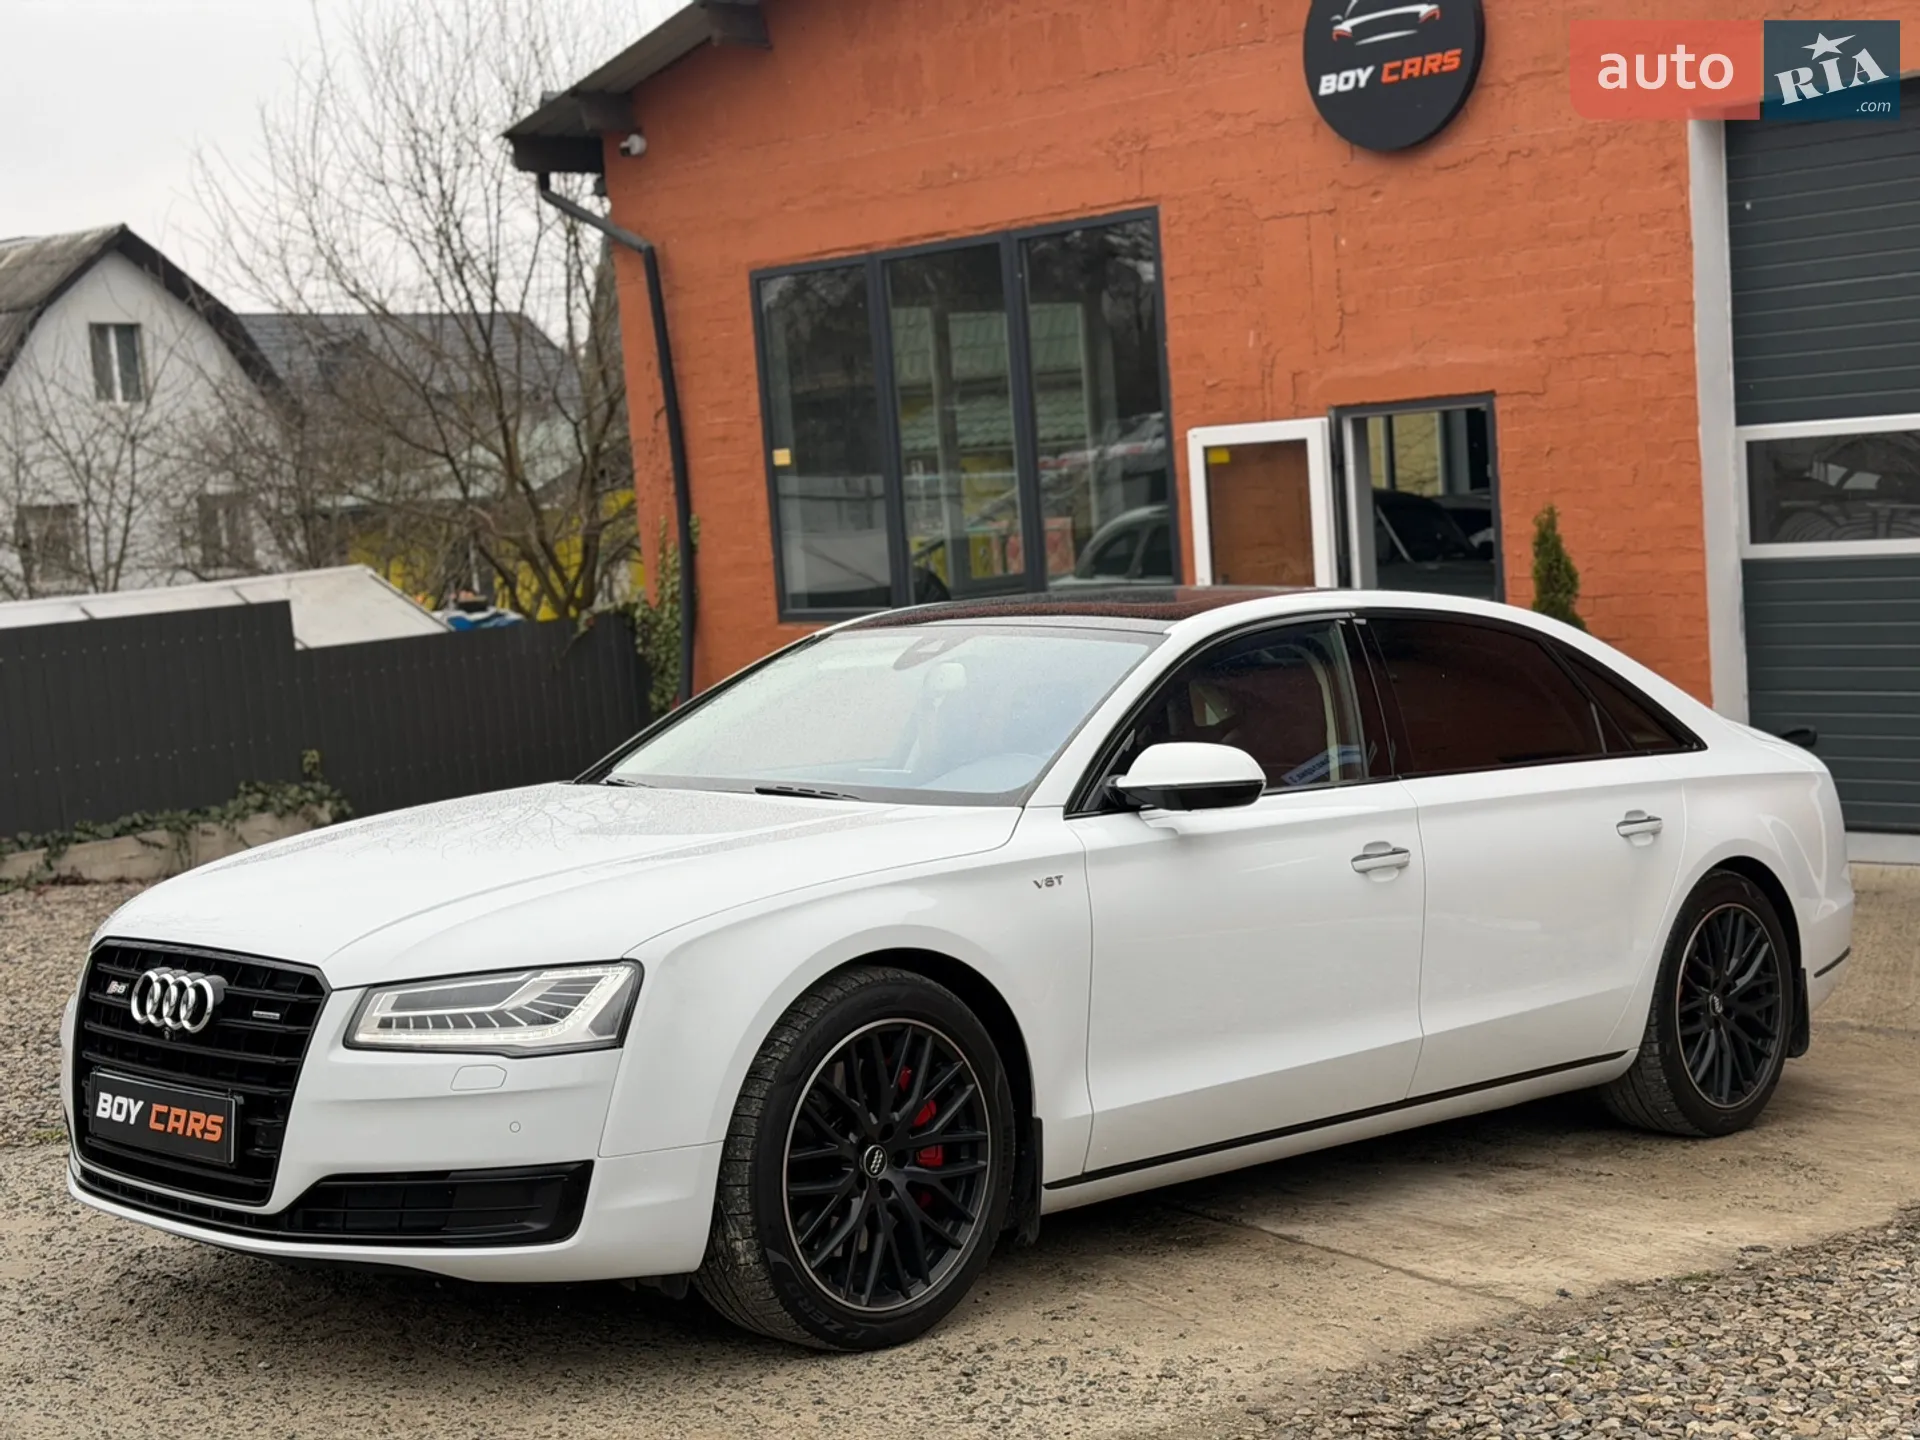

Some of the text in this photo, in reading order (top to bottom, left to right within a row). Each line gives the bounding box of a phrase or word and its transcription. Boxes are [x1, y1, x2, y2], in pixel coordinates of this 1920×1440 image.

[1318, 48, 1462, 96] BOY CARS
[1033, 874, 1064, 889] V8T
[96, 1091, 224, 1142] BOY CARS
